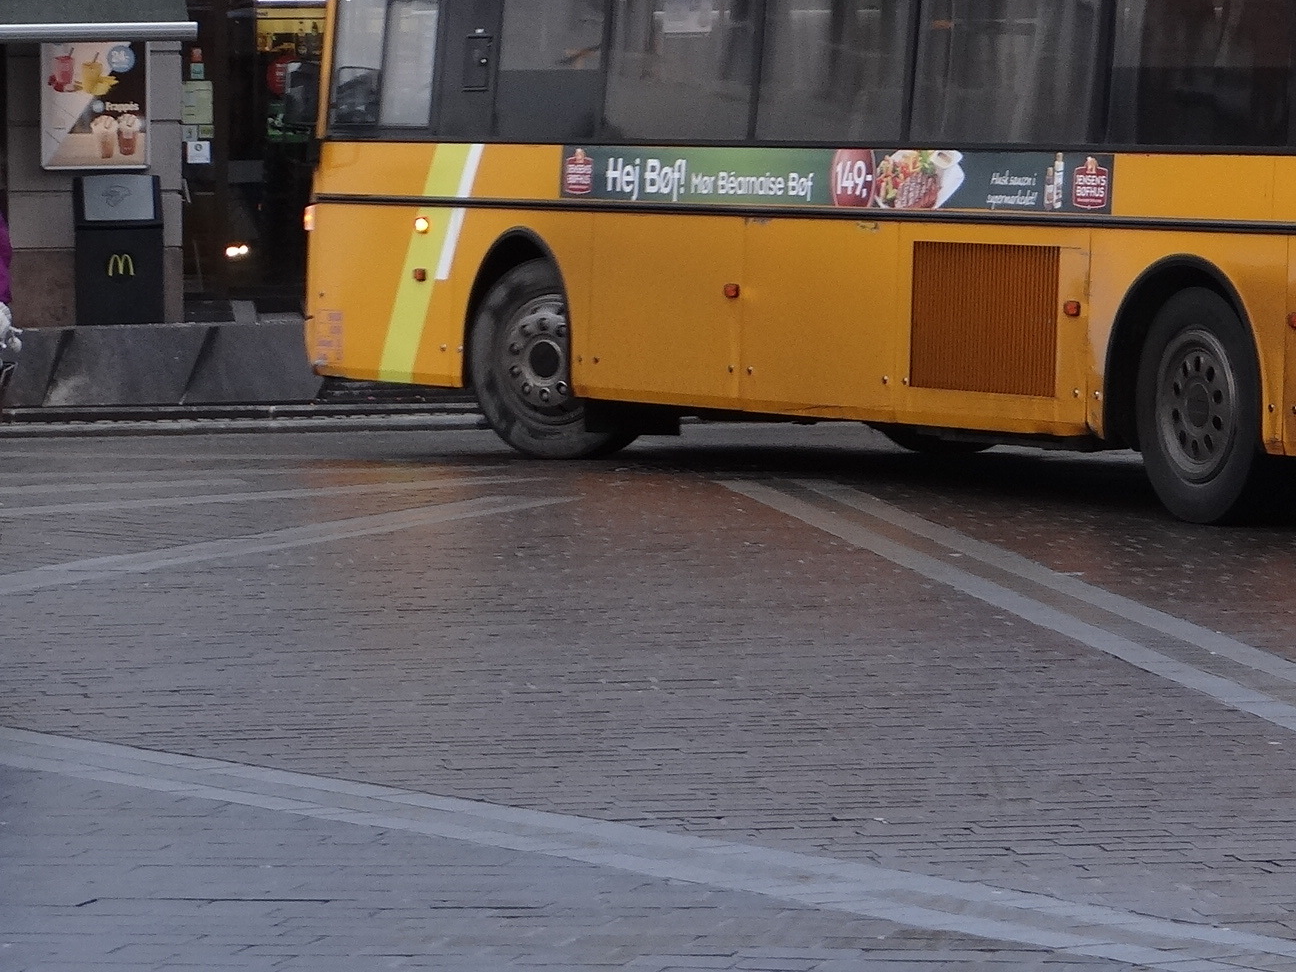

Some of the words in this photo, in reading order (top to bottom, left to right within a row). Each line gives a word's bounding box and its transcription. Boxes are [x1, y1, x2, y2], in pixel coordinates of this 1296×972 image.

[606, 157, 640, 201] Hej
[644, 158, 687, 202] Bøf!
[690, 172, 715, 194] Mør
[717, 171, 785, 196] Béarnaise
[787, 172, 815, 201] Bøf
[1075, 174, 1107, 186] JENSEN'S
